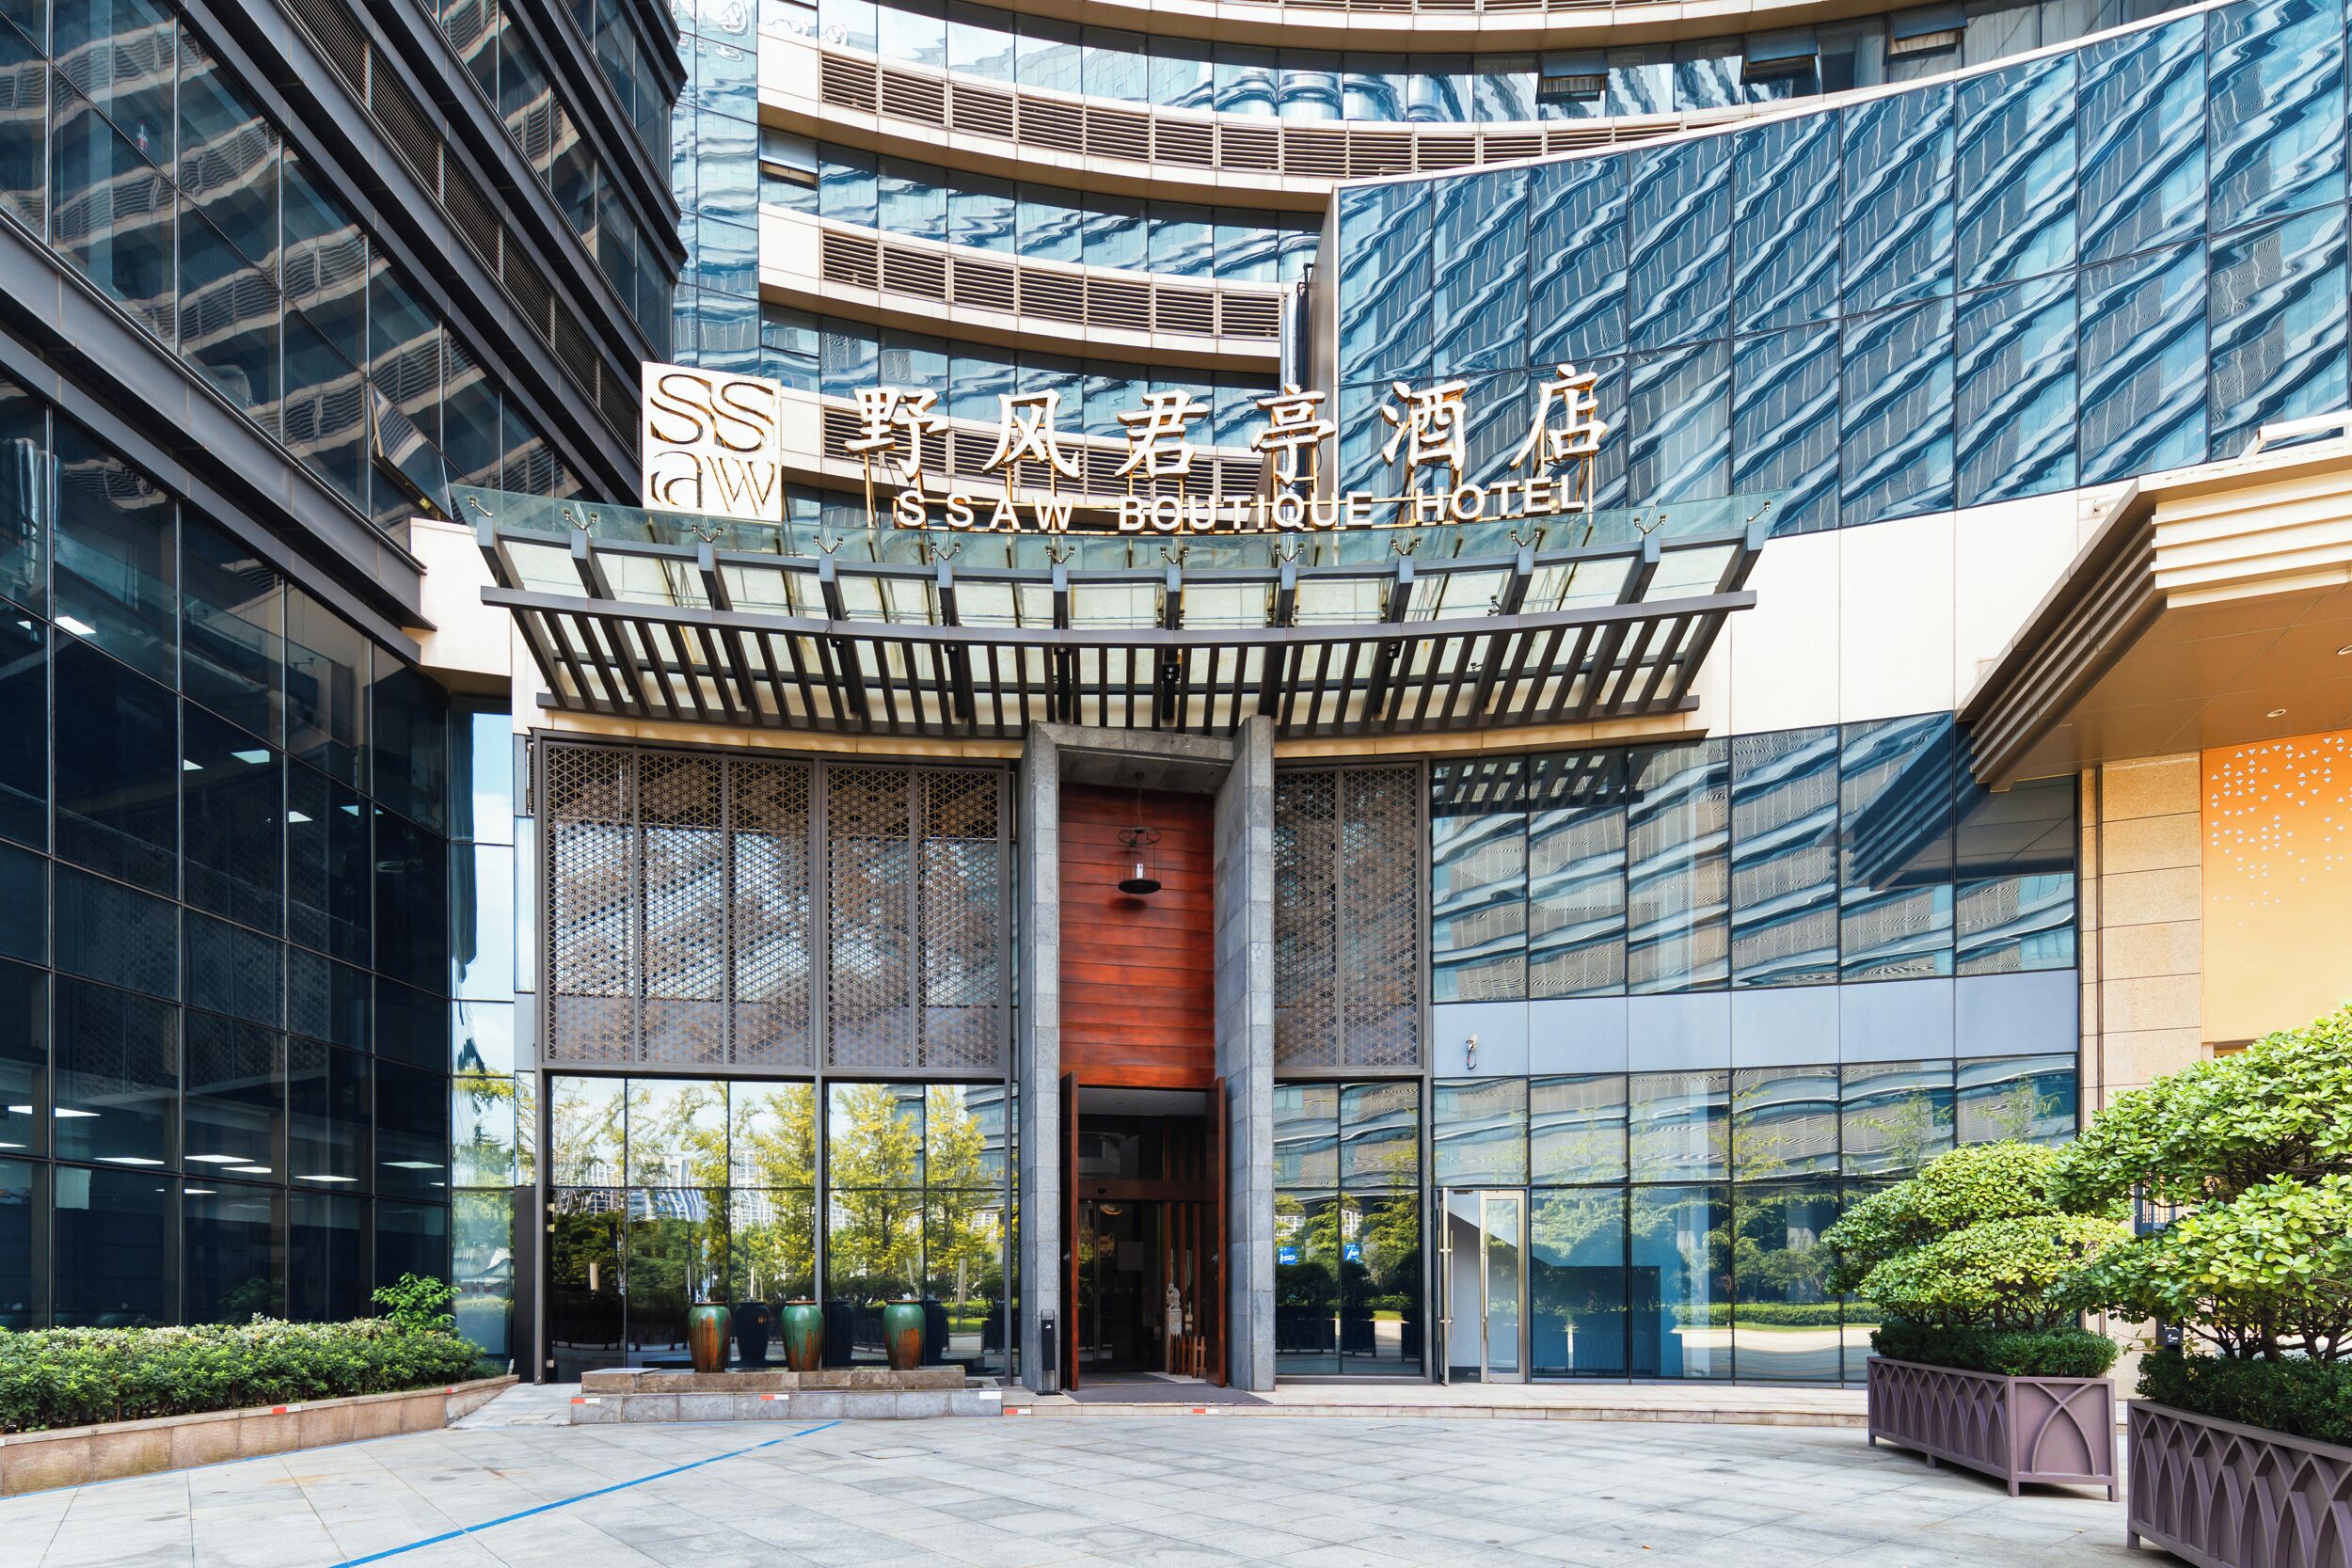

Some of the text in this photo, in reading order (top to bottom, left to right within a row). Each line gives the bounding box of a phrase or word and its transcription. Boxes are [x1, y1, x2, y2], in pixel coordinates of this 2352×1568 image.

[845, 364, 1608, 486] 野风君亭酒店
[897, 473, 1585, 533] SSAW BOUTIQUE HOTEL
